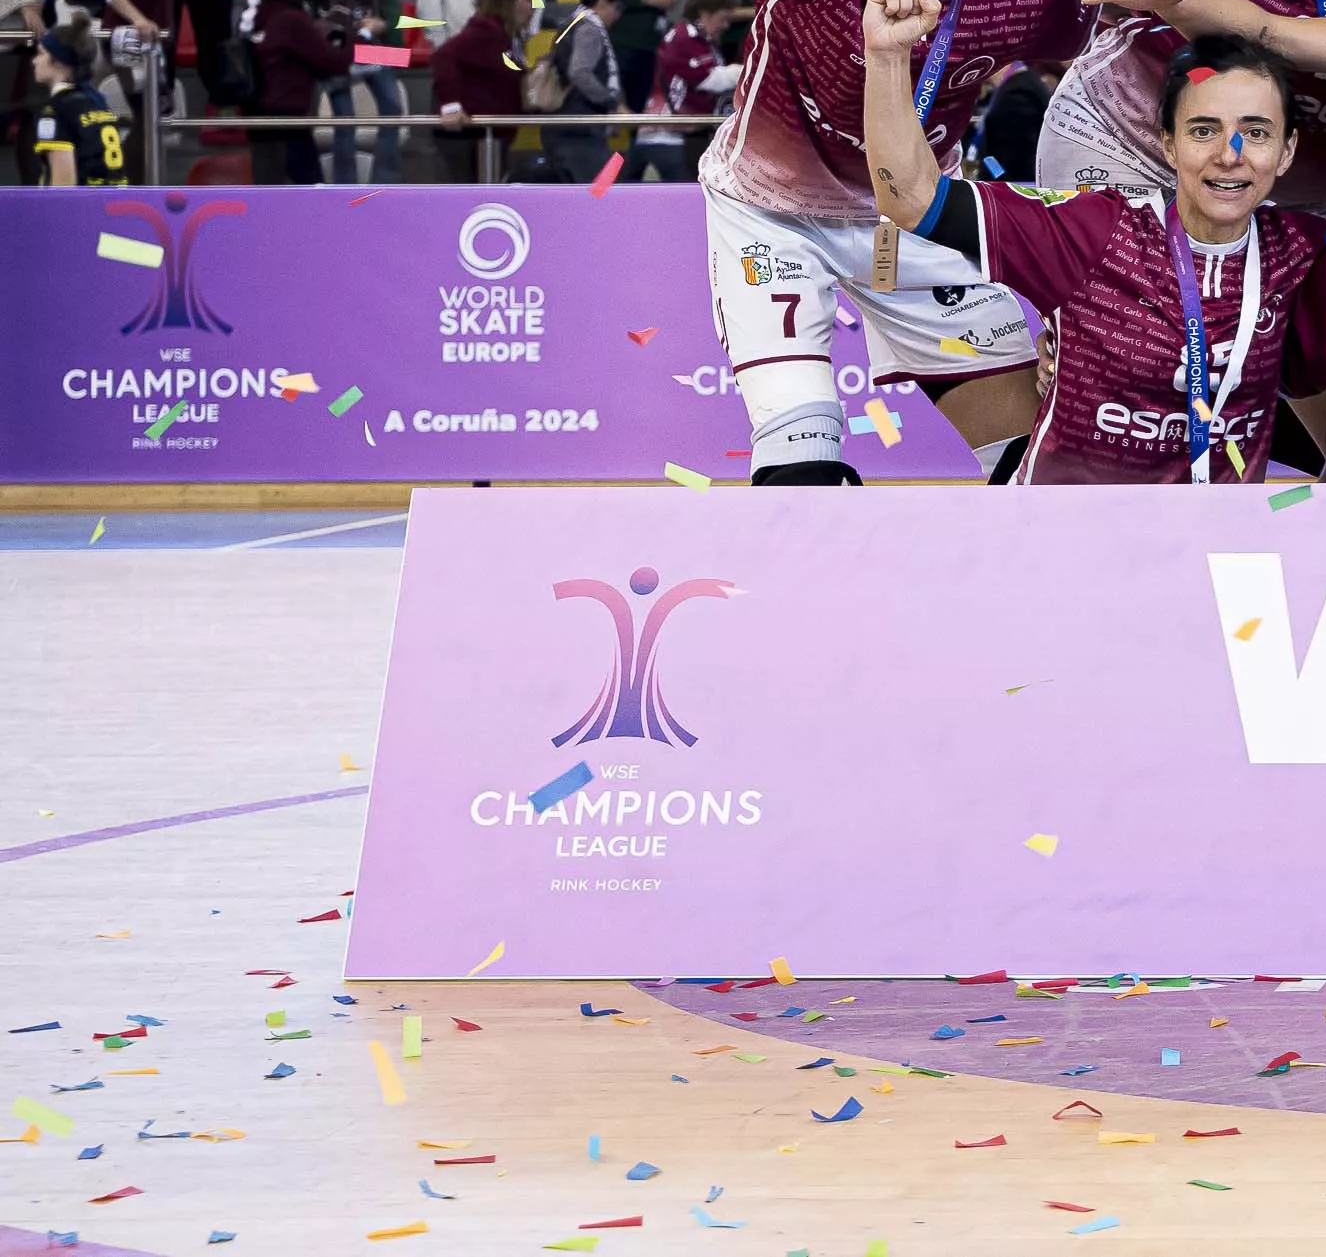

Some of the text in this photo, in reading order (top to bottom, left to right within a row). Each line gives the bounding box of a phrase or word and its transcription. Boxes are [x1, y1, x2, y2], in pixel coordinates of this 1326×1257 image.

[963, 3, 990, 11] Annabel
[916, 35, 949, 119] PIONSLEAGUE
[101, 125, 123, 168] 8
[1068, 125, 1094, 140] Stefania
[1097, 139, 1116, 151] Nuria
[1115, 184, 1149, 196] Fraga
[1102, 258, 1126, 275] Pamela
[439, 286, 545, 310] WORLD
[941, 298, 988, 318] LUCHAREMOS
[440, 310, 545, 336] SKATE
[771, 294, 801, 338] 7
[1124, 307, 1142, 317] Carla
[442, 342, 541, 363] EUROPE
[62, 368, 290, 400] CHAMPIONS
[132, 403, 219, 424] LEAGUE
[384, 408, 599, 434] A Coruña 2024
[600, 765, 640, 780] WSE
[469, 789, 763, 827] CHAMPIONS
[555, 835, 668, 859] LEAGUE
[550, 878, 662, 892] RINK HOCKEY
